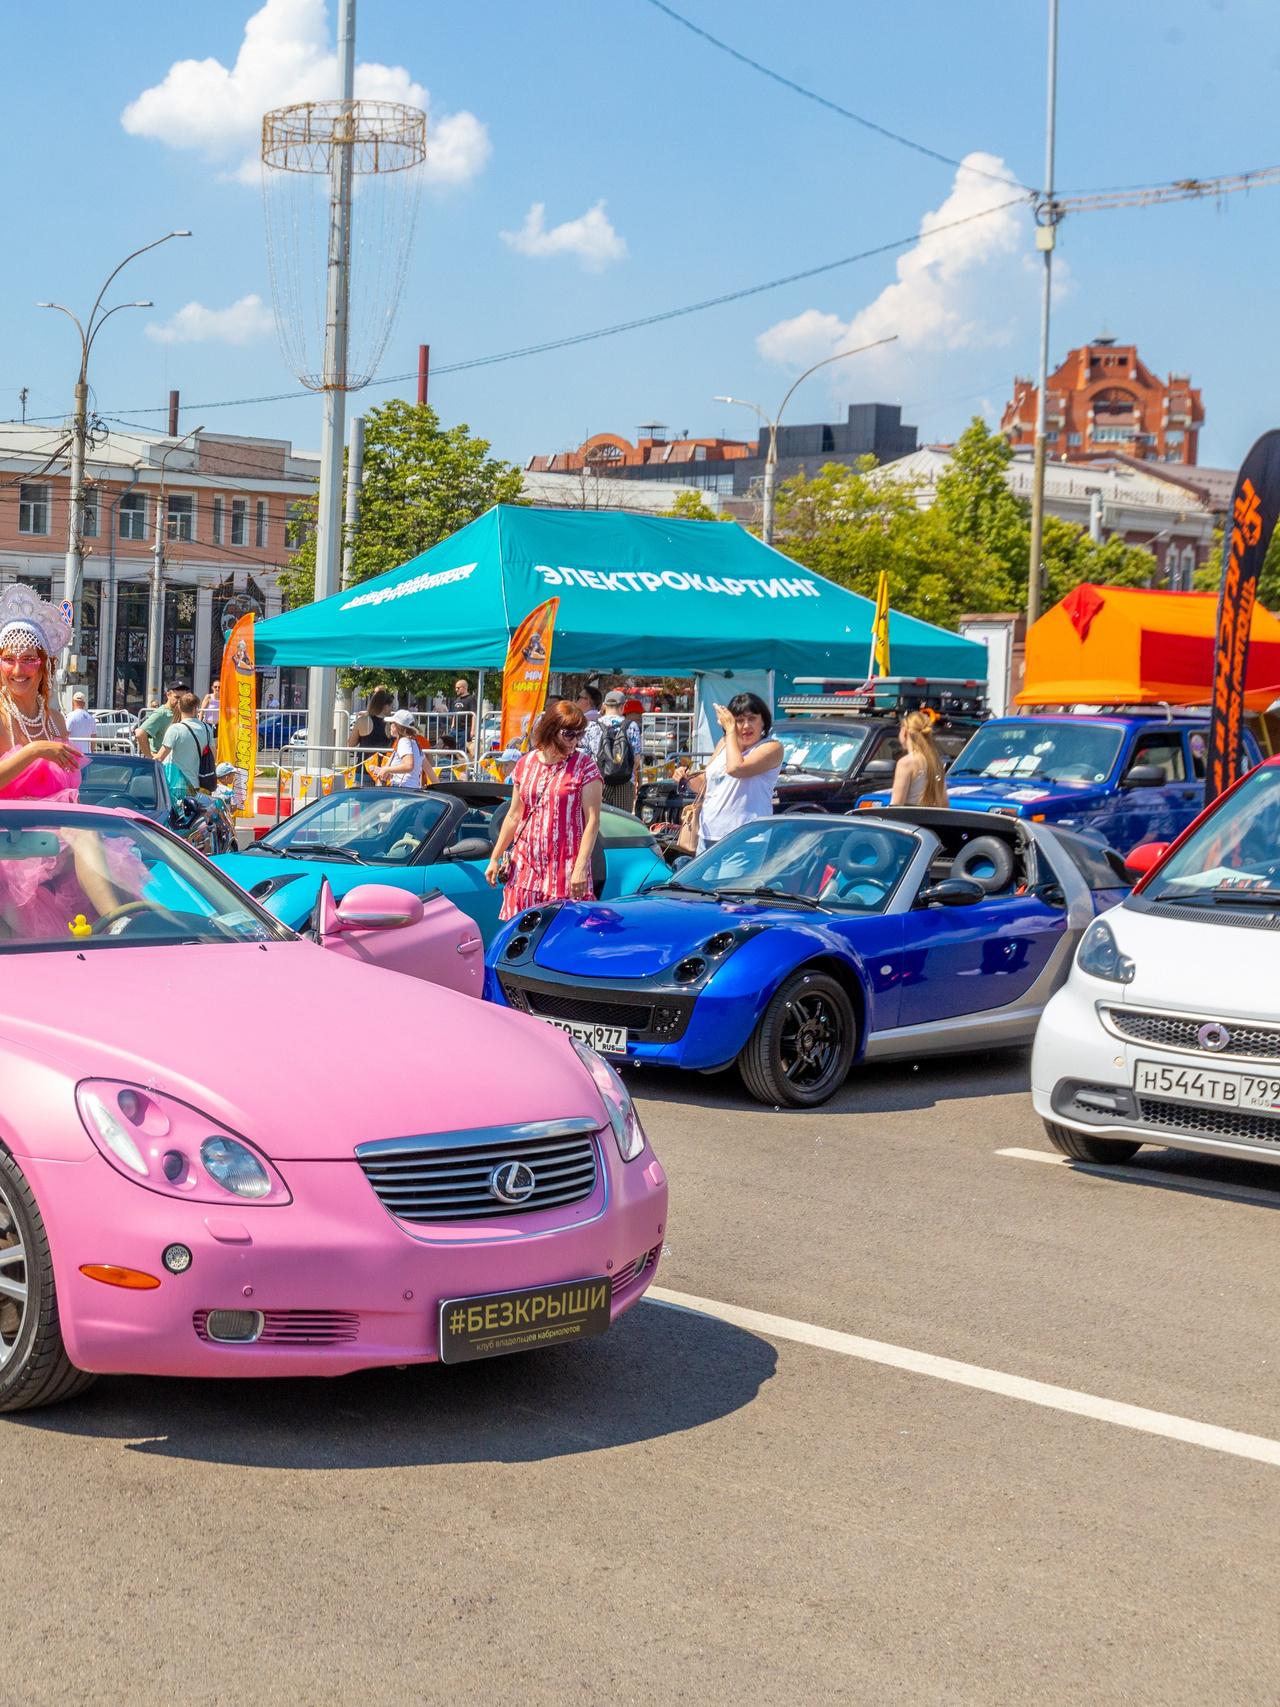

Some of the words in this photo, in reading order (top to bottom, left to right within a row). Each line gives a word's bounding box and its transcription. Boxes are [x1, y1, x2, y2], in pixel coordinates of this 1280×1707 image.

[534, 565, 821, 598] ЭЛЕКТРОКАРТИНГ
[235, 681, 252, 770] KARTING
[595, 1027, 622, 1044] 977
[602, 1043, 615, 1051] RUS
[1144, 1068, 1237, 1101] Н544ТВ
[1243, 1077, 1280, 1100] 799
[1251, 1097, 1270, 1107] RUS
[449, 1285, 607, 1335] #БЕЗКРЫШИ
[476, 1340, 494, 1351] клуб
[495, 1333, 537, 1348] владельцев
[537, 1324, 581, 1340] кабриолетов
